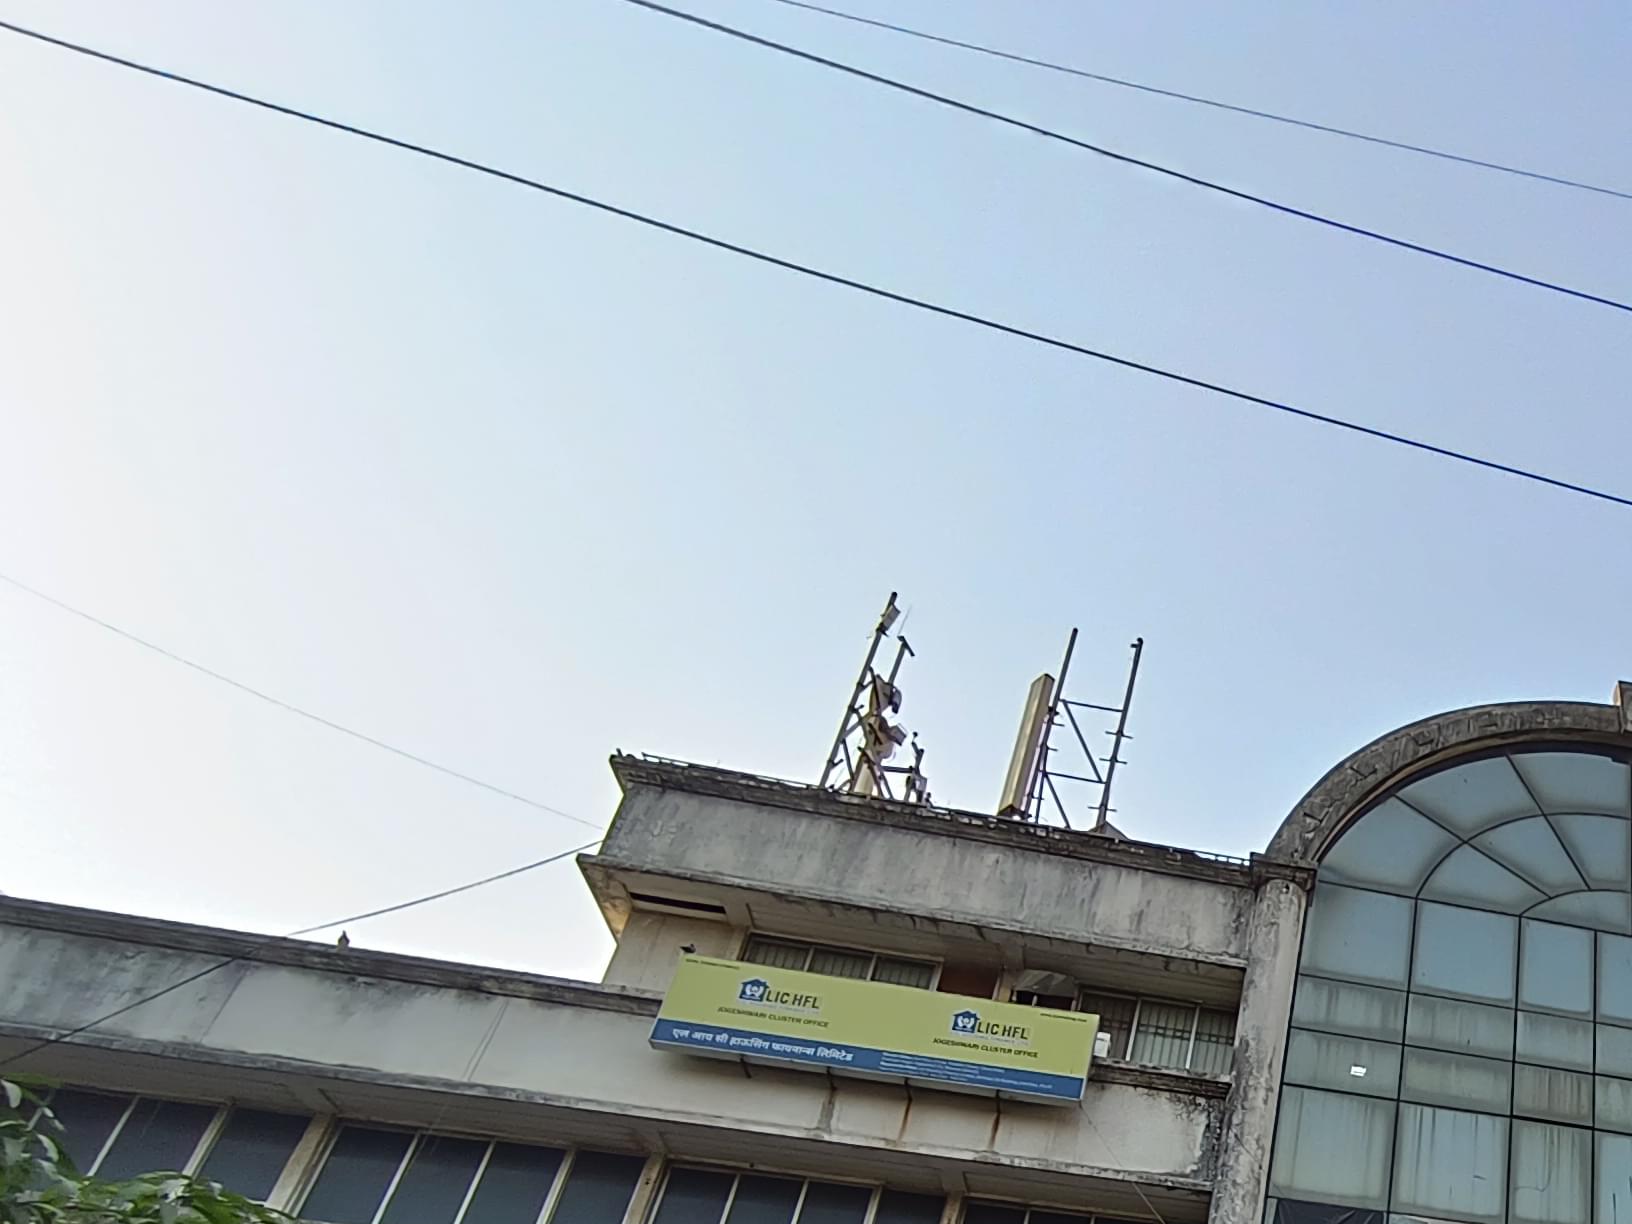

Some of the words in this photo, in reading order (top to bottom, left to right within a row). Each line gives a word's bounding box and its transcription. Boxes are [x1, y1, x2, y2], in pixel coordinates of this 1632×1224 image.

[766, 990, 790, 1004] LIC
[792, 994, 820, 1009] HFL
[803, 1018, 829, 1028] OFFICE
[977, 1021, 999, 1036] LIC
[1002, 1026, 1029, 1040] HFL
[1014, 1049, 1038, 1058] OFFICE
